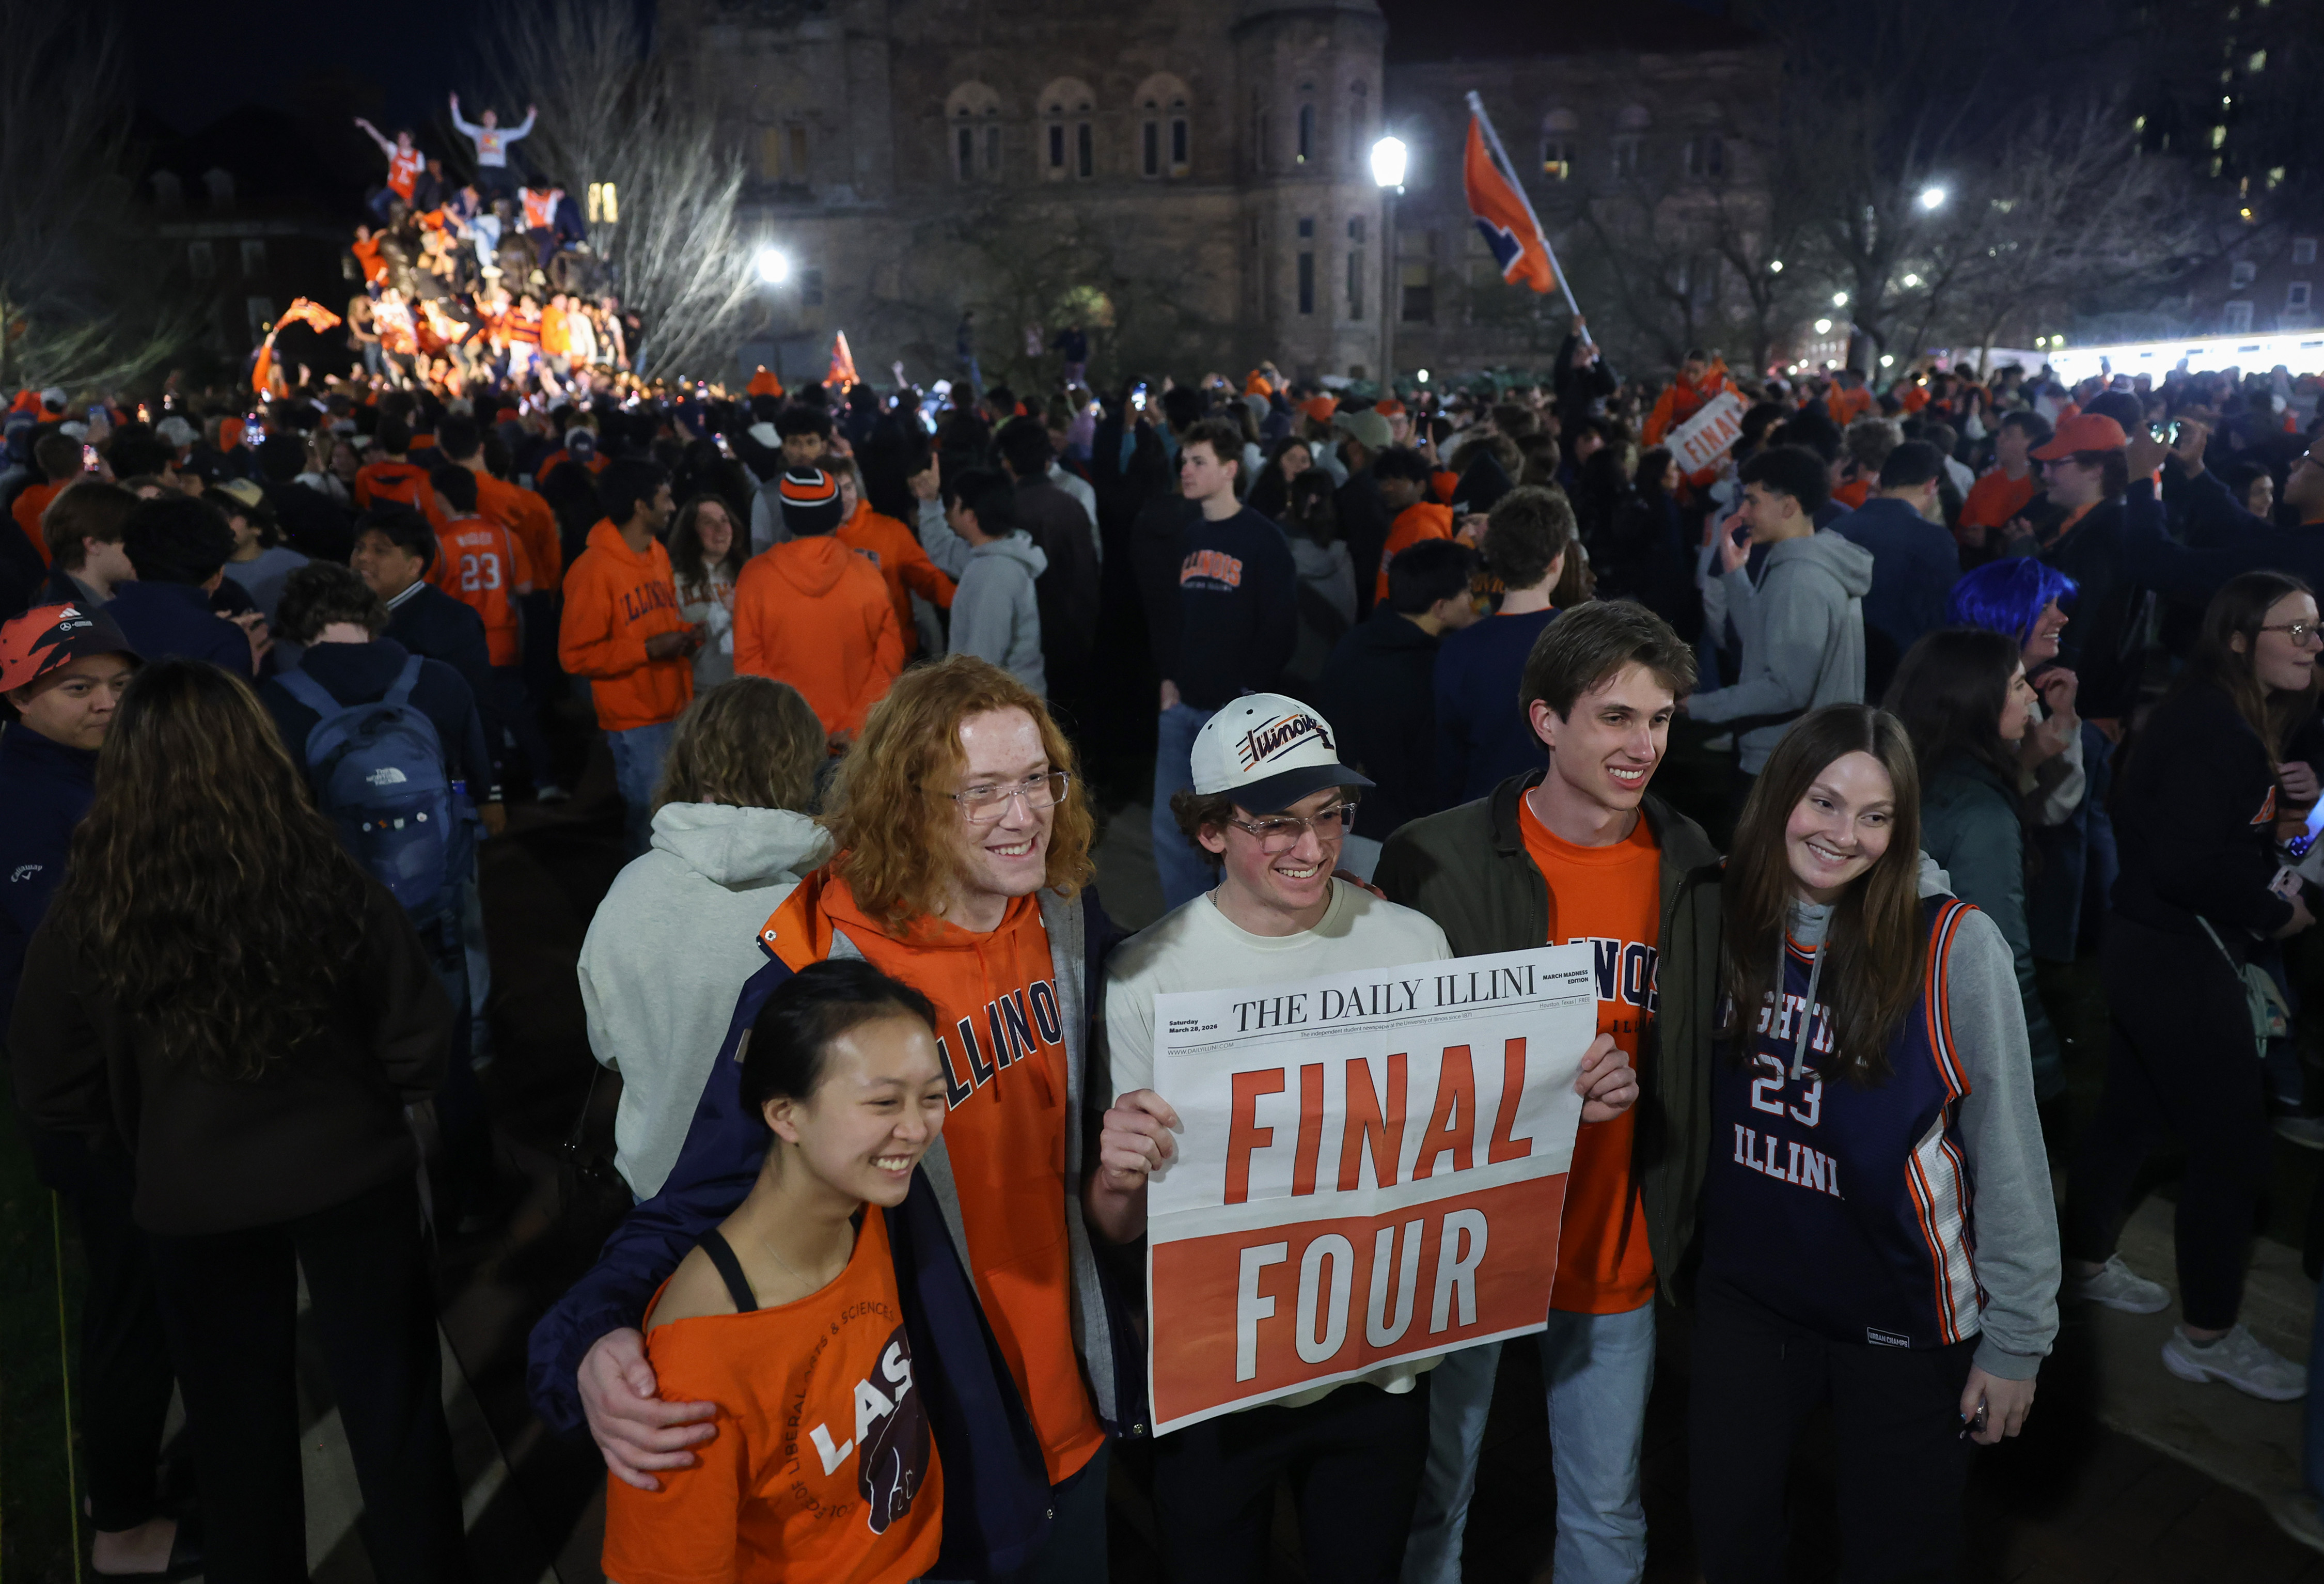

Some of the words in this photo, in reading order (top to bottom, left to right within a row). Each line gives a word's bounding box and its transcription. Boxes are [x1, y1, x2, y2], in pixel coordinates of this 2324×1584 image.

[460, 553, 500, 591] 23
[1232, 993, 1308, 1032] THE
[1318, 979, 1424, 1021] DAILY
[1434, 964, 1537, 1007] ILLINI
[937, 979, 1063, 1111] LLINO
[1168, 1042, 1234, 1056] WWW.DAILYILLINI.COM
[1224, 1036, 1533, 1205] FINAL
[1750, 1052, 1824, 1128] 23
[1734, 1122, 1841, 1198] ILLINI
[1236, 1208, 1488, 1383] FOUR
[1886, 1336, 1908, 1348] CHAMPS
[785, 1389, 807, 1475] LIBERAL
[809, 1341, 913, 1477] LAS
